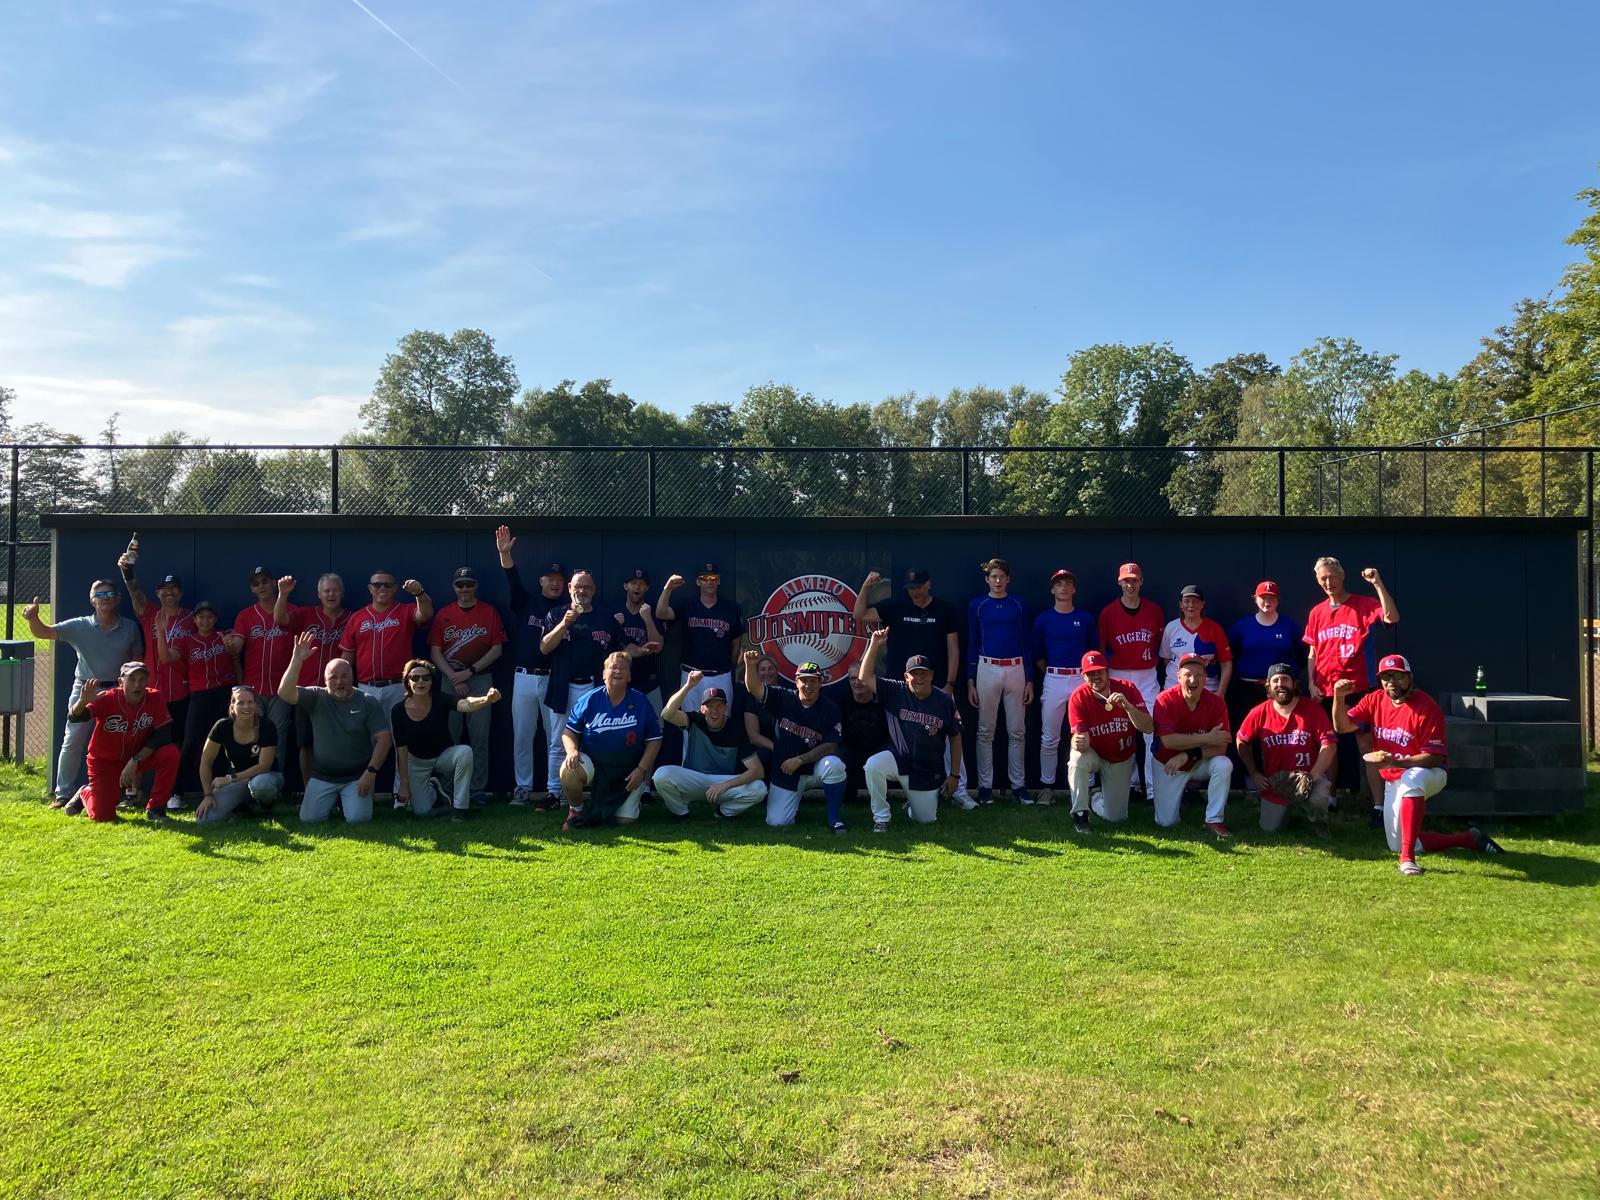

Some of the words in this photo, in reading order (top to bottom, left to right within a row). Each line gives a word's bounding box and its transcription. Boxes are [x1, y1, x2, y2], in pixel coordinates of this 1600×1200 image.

[1126, 565, 1135, 573] T
[782, 576, 845, 599] ALMELO
[305, 624, 341, 644] Eagl
[443, 624, 488, 641] Eagles
[1115, 631, 1153, 646] TIGERS
[1318, 627, 1353, 642] TIGERS
[190, 644, 225, 664] Eagle
[1142, 648, 1152, 661] 41
[1340, 644, 1355, 658] 12
[1087, 656, 1095, 664] T
[103, 712, 153, 737] Eagle
[586, 712, 637, 729] Mamba
[1090, 721, 1128, 737] TIGERS
[626, 731, 636, 747] 8
[1119, 737, 1133, 751] 10
[1263, 732, 1308, 748] TIGERS
[1295, 752, 1311, 767] 21
